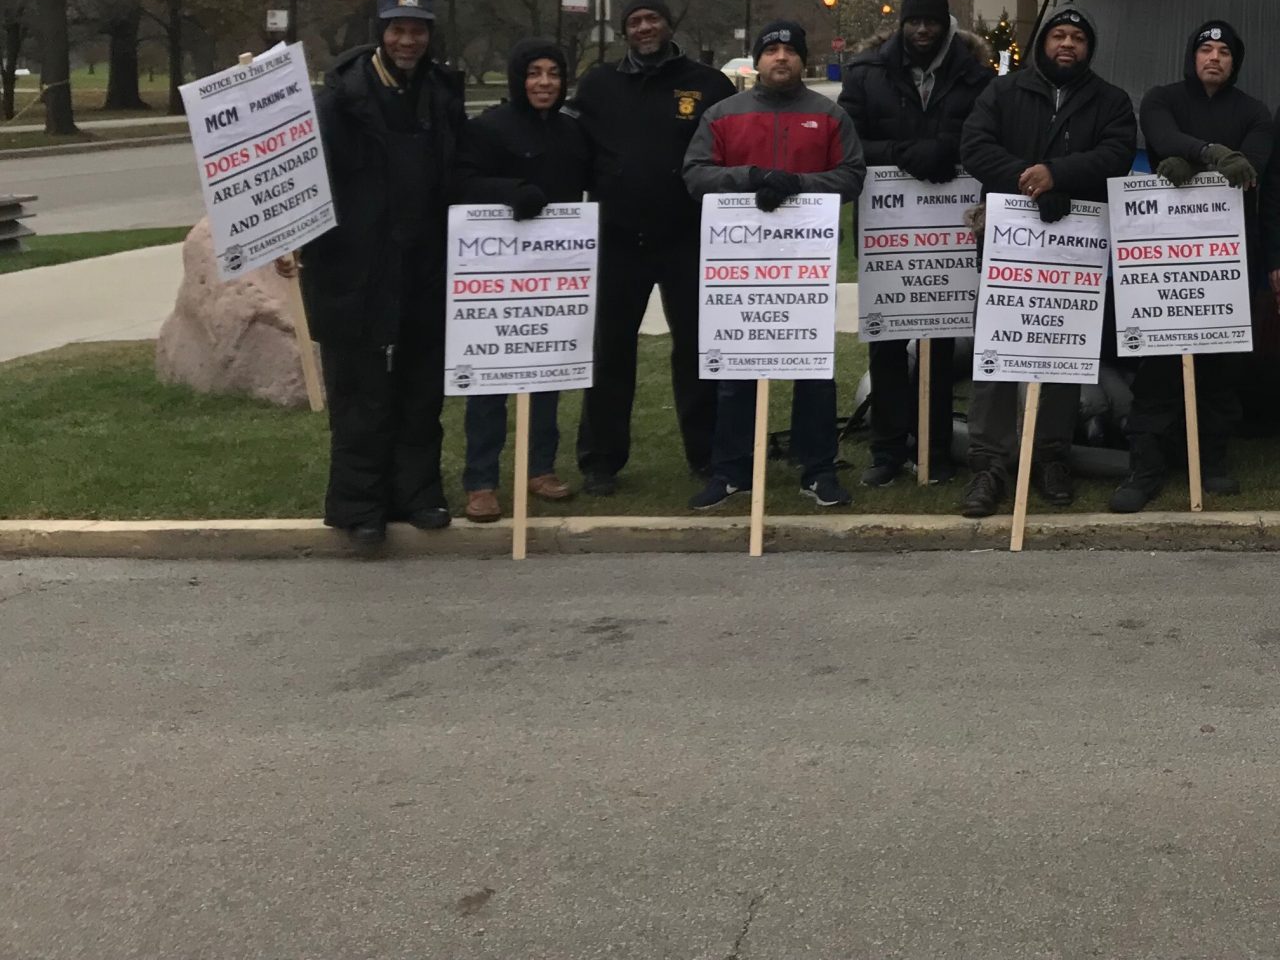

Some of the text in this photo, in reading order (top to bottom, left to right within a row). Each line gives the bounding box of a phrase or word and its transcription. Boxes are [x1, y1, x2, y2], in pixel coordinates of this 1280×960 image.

[199, 77, 232, 97] NOTICE
[233, 71, 247, 82] TO
[204, 106, 238, 133] MCM
[250, 89, 286, 112] PARKING
[204, 118, 314, 179] DOES NOT PAY
[213, 146, 318, 205] AREA STANDARD
[1124, 179, 1156, 189] NOTICE
[1160, 179, 1171, 187] TO
[1195, 176, 1226, 185] PUBLIC
[251, 178, 295, 206] WAGES
[717, 198, 750, 206] NOTICE
[789, 198, 823, 206] PUBLIC
[872, 194, 978, 209] MCM PARKING INC.
[1004, 198, 1101, 214] NOTICE PUBLIC
[1125, 200, 1230, 216] MCM PARKING INC.
[229, 185, 318, 237] AND BENEFITS
[467, 209, 504, 218] NOTICE
[546, 208, 581, 216] PUBLIC
[249, 227, 296, 255] TEAMSTERS
[710, 225, 834, 244] MCM PARKING
[864, 232, 976, 249] DOES NOT PA
[993, 225, 1108, 249] MCM PARKING
[458, 237, 596, 257] MCM PARKING
[1118, 242, 1240, 261] DOES NOT PAY
[705, 265, 831, 280] DOES NOT PAY
[865, 258, 978, 272] AREA STANDAR
[902, 275, 949, 286] WAGES
[987, 266, 1103, 286] DOES NOT PAY
[1120, 269, 1241, 285] AREA STANDARD
[453, 276, 590, 294] DOES NOT PAY
[705, 293, 828, 305] AREA STANDARD
[874, 290, 976, 304] AND BENEFITS
[1158, 288, 1205, 300] WAGES
[986, 294, 1098, 311] AREA STANDARD
[453, 304, 588, 320] AREA STANDARD
[741, 311, 789, 323] WAGES
[1131, 303, 1233, 318] AND BENEFITS
[889, 318, 940, 327] TEAMSTERS
[1021, 314, 1064, 327] WAGES
[496, 323, 548, 337] WAGES
[714, 328, 817, 341] AND BENEFITS
[990, 330, 1087, 345] AND BENEFITS
[1148, 330, 1245, 342] TEAMSTERS LOCAL 727
[463, 340, 577, 356] AND BENEFITS
[728, 358, 778, 366] TEAMSTERS
[813, 357, 827, 365] 727
[1003, 360, 1093, 370] TEAMSTERS LOCAL 727
[480, 367, 586, 381] TEAMSTERS LOCAL 727
